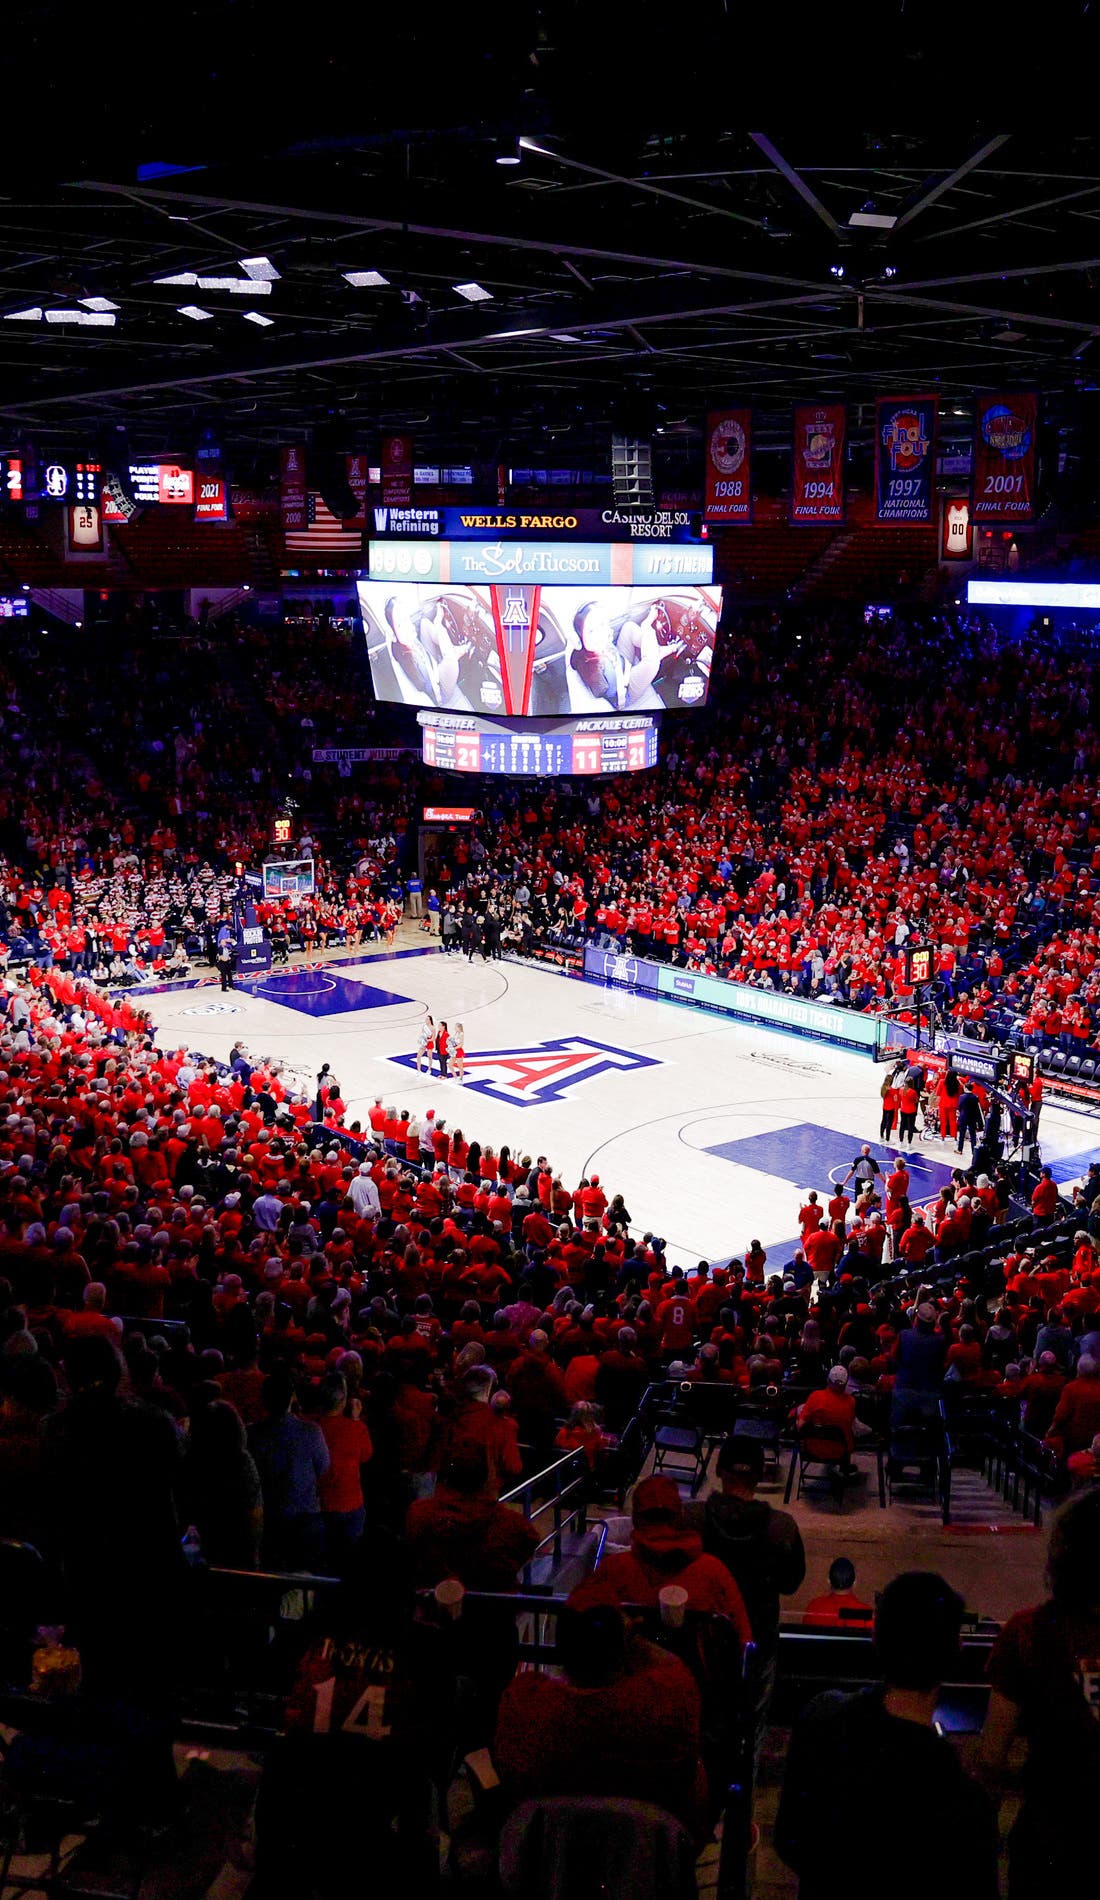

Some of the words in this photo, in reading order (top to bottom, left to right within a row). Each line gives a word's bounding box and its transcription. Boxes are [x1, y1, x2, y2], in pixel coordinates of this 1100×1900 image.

[882, 413, 927, 445] Final
[890, 439, 930, 471] Four
[7, 470, 21, 489] 2
[984, 475, 1024, 494] 2001
[200, 483, 219, 498] 2021
[714, 481, 743, 497] 1988
[804, 482, 834, 498] 1994
[889, 479, 922, 497] 1997
[729, 504, 748, 512] FOUR
[795, 506, 817, 515] FINAL
[819, 506, 841, 515] FOUR
[883, 498, 926, 508] NATIONAL
[975, 502, 1002, 511] FINAL
[1004, 501, 1030, 511] FOUR
[389, 508, 438, 520] Western
[654, 511, 674, 524] DEL
[675, 512, 690, 525] SOL
[878, 509, 929, 518] CHAMPIONS
[80, 517, 93, 528] 25
[390, 520, 439, 535] Refining
[460, 515, 517, 528] WELLS
[520, 516, 578, 529] FARGO
[952, 523, 964, 535] 00
[630, 525, 673, 537] RESORT
[462, 556, 486, 572] The
[481, 541, 523, 576] Sol
[523, 556, 538, 573] of
[538, 553, 600, 572] Tucson
[500, 598, 530, 626] A
[576, 719, 622, 731] MCKALE
[622, 717, 653, 729] CENTER
[457, 747, 479, 768] 21
[575, 750, 598, 769] 11
[629, 746, 645, 767] 21
[275, 828, 290, 841] 30
[912, 963, 927, 981] 30
[758, 994, 808, 1023] GUARANTEED
[808, 1008, 844, 1033] TICKETS
[952, 1055, 994, 1071] SHAMROCK
[1016, 1066, 1028, 1078] 30
[312, 1675, 393, 1741] 14
